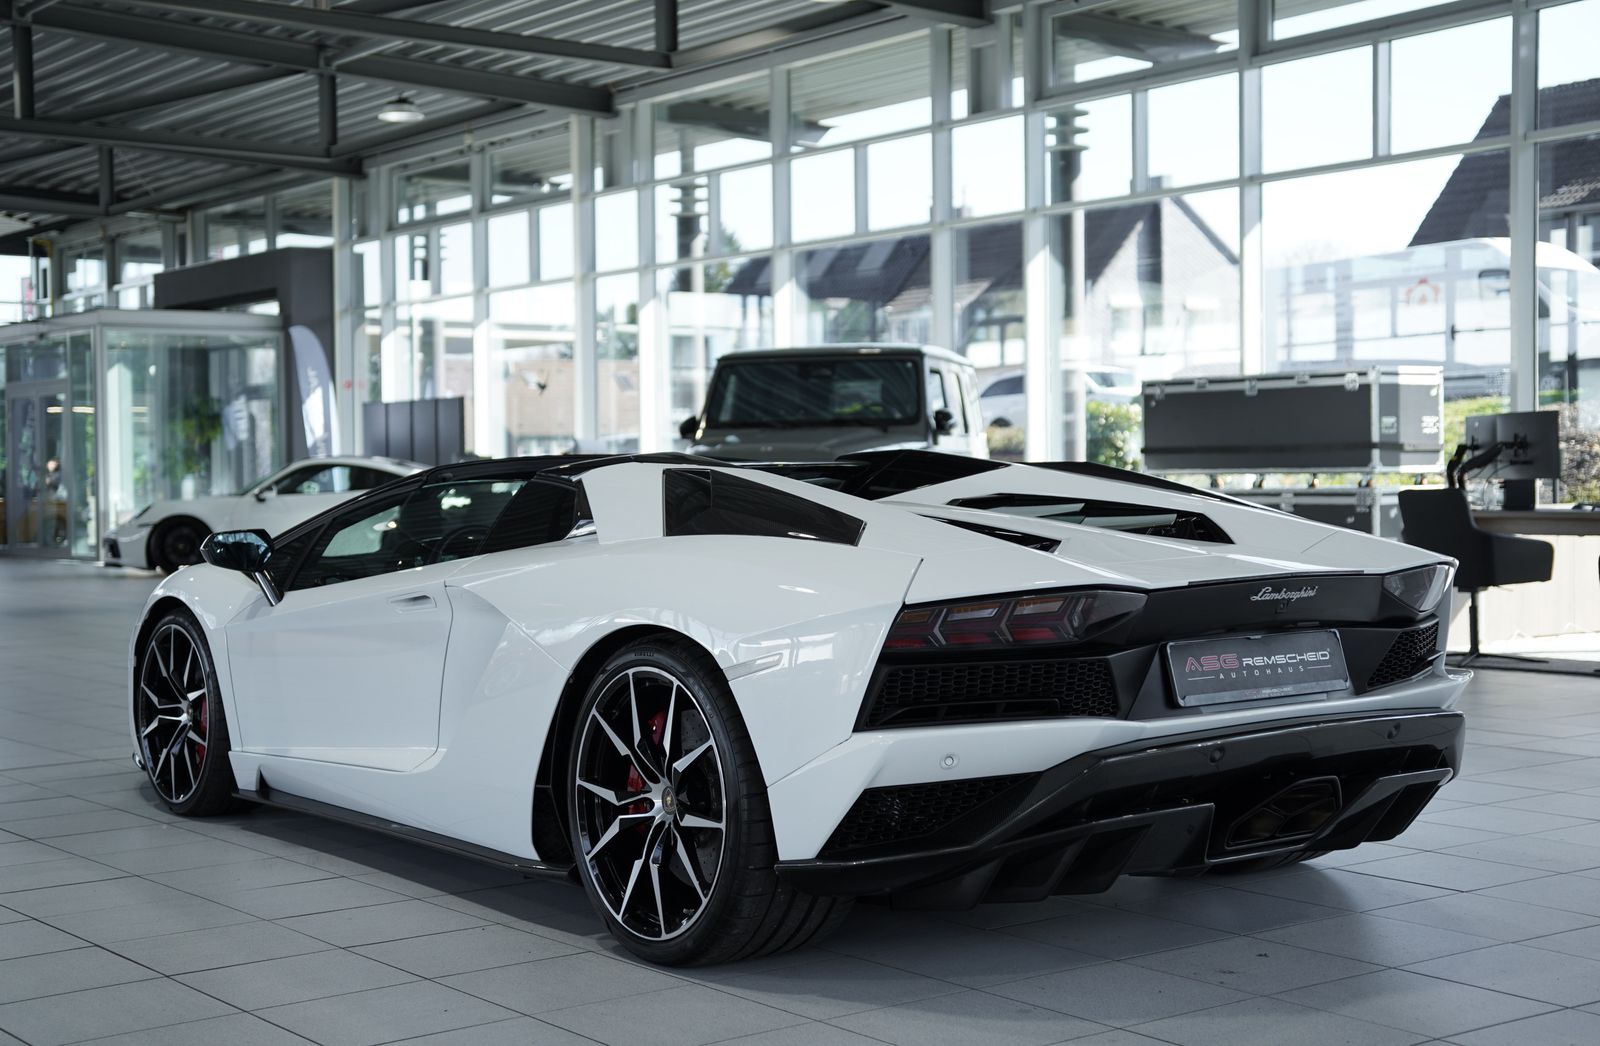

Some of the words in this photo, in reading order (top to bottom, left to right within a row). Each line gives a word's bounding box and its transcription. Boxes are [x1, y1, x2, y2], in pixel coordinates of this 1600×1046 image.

[1250, 586, 1318, 601] Lamborghini
[1185, 653, 1239, 672] ASG
[1242, 651, 1330, 667] REMSCHEID
[1219, 665, 1305, 679] AUTOHAUS
